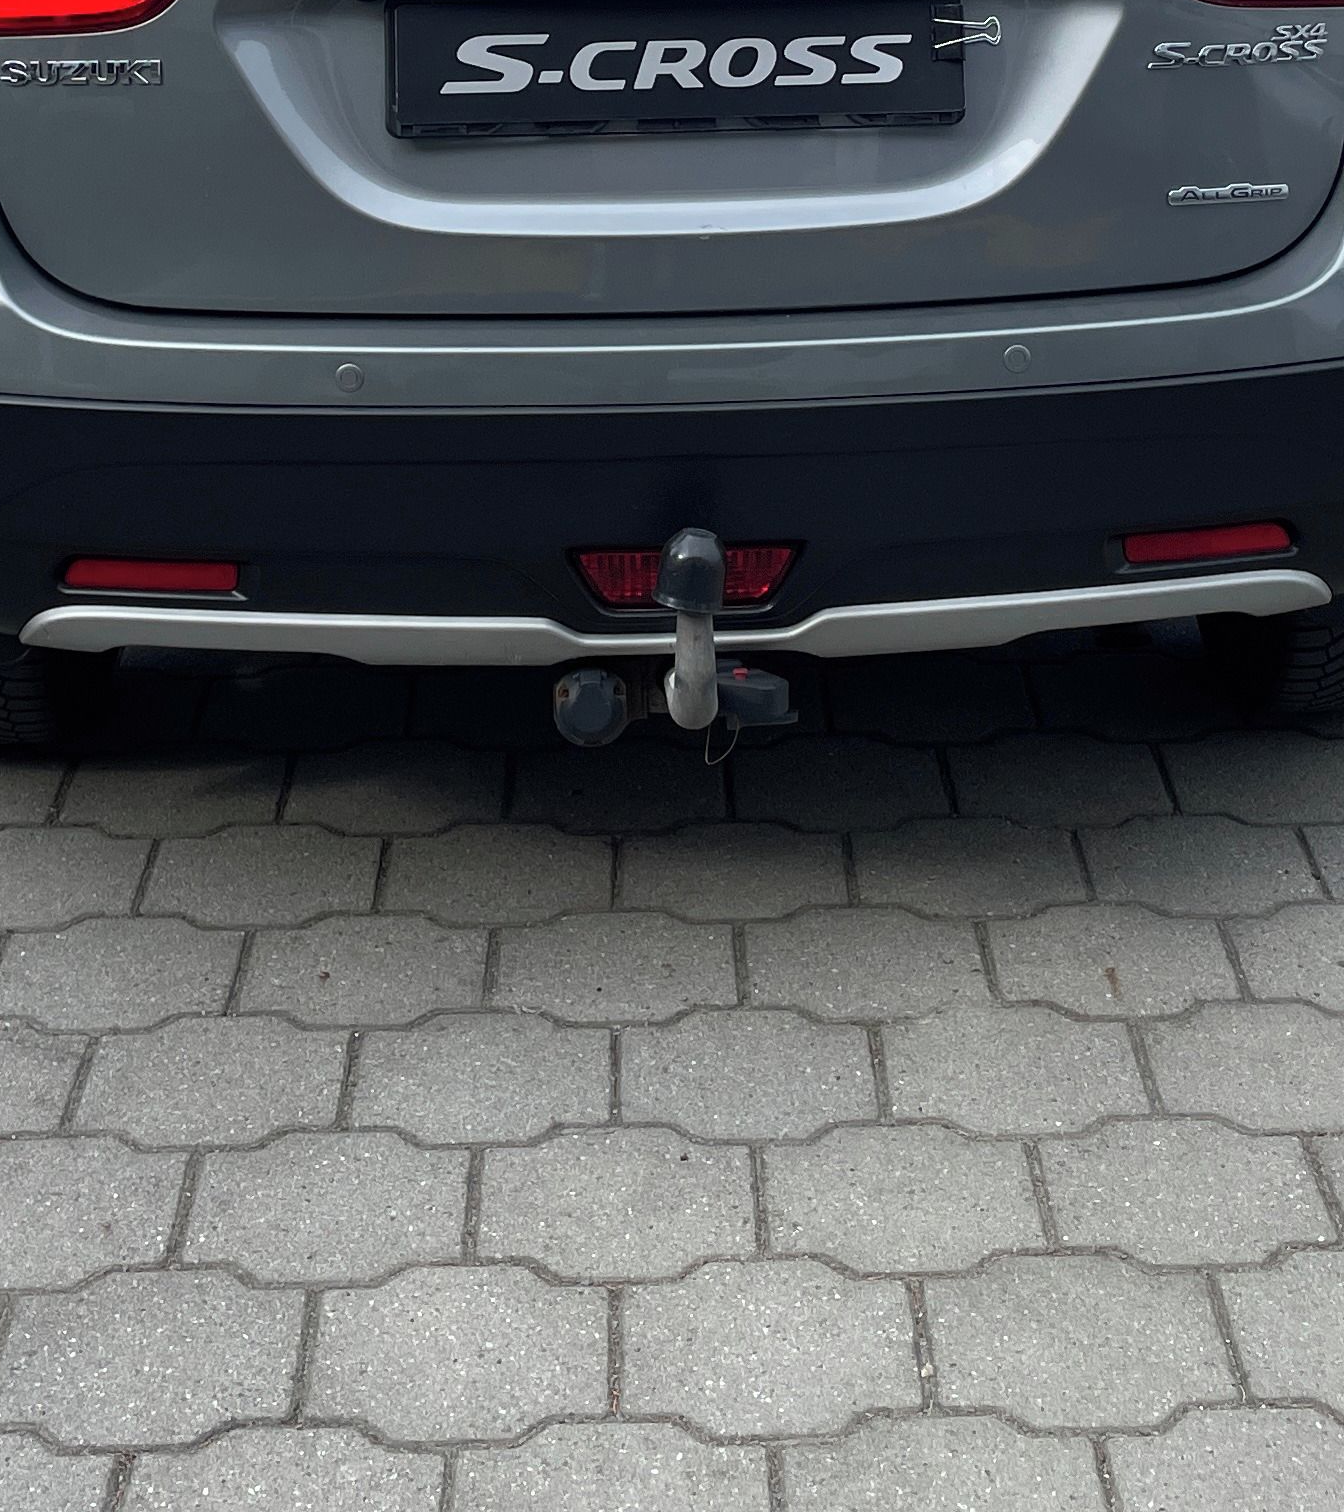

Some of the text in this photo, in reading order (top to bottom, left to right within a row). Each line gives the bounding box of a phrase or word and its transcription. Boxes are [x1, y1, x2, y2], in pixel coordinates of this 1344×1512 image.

[1270, 22, 1328, 41] SX4
[439, 33, 913, 95] S-CROSS
[1147, 39, 1328, 69] S-CROSS
[0, 59, 164, 87] SUZUKI
